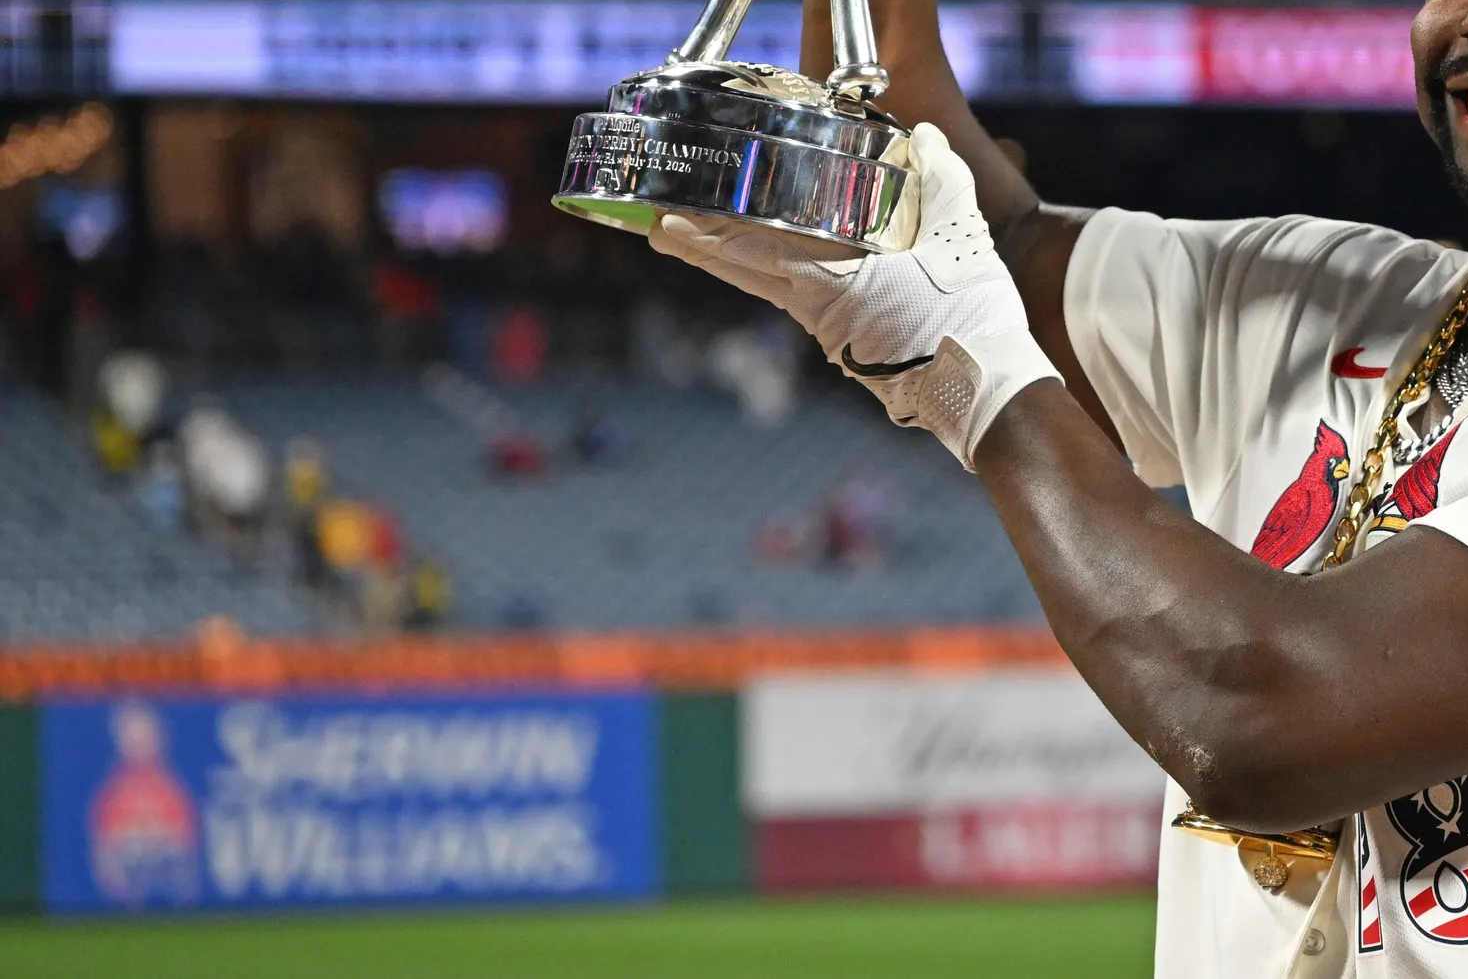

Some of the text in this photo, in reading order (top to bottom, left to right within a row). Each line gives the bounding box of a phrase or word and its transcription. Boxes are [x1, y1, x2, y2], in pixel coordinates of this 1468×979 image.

[596, 135, 642, 152] DERBY
[644, 138, 743, 168] CHAMPION
[623, 154, 646, 170] July
[647, 157, 662, 171] 13,
[665, 160, 692, 174] 2026
